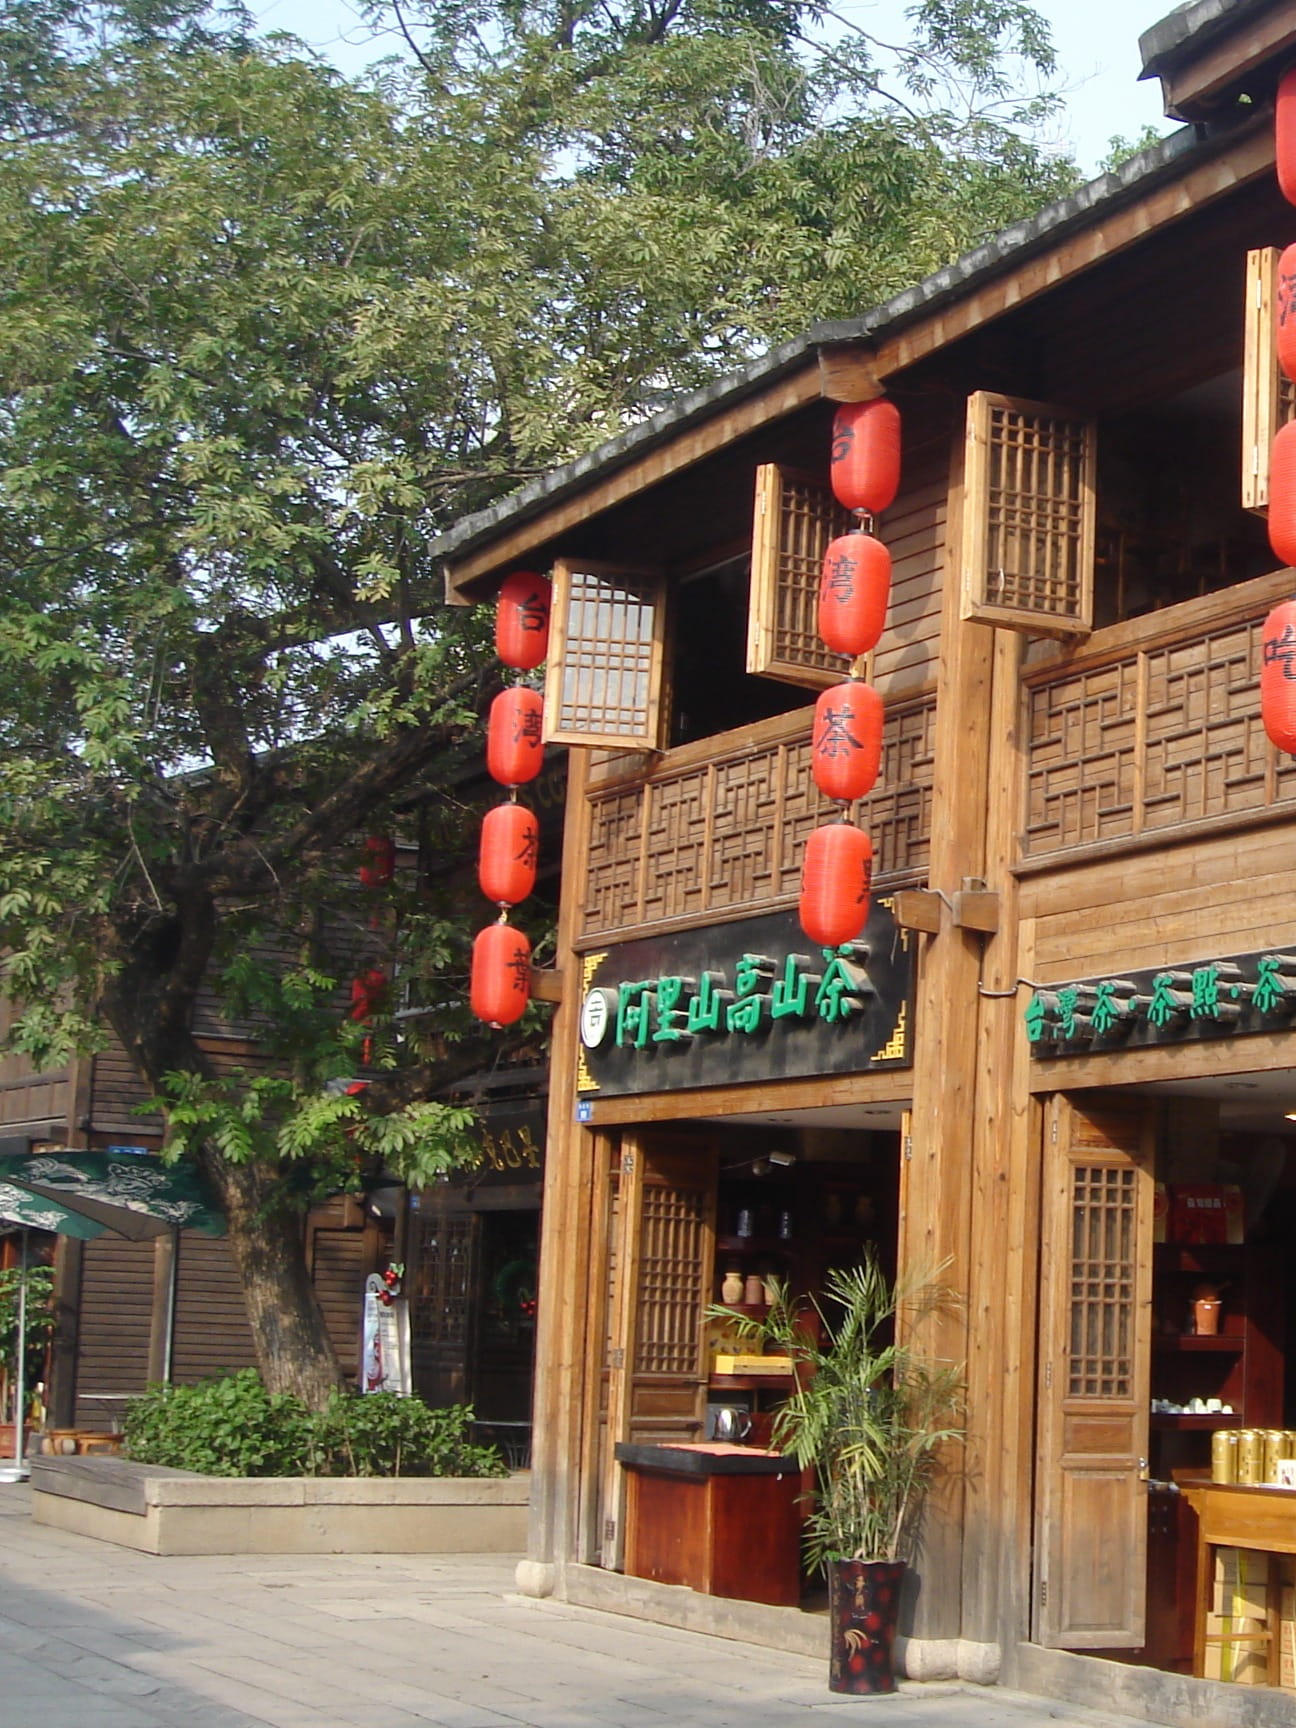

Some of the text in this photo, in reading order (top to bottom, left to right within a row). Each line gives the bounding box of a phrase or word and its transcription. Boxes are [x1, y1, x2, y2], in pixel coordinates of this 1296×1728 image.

[815, 703, 865, 759] 茶
[616, 945, 858, 1049] 阿里山高山茶
